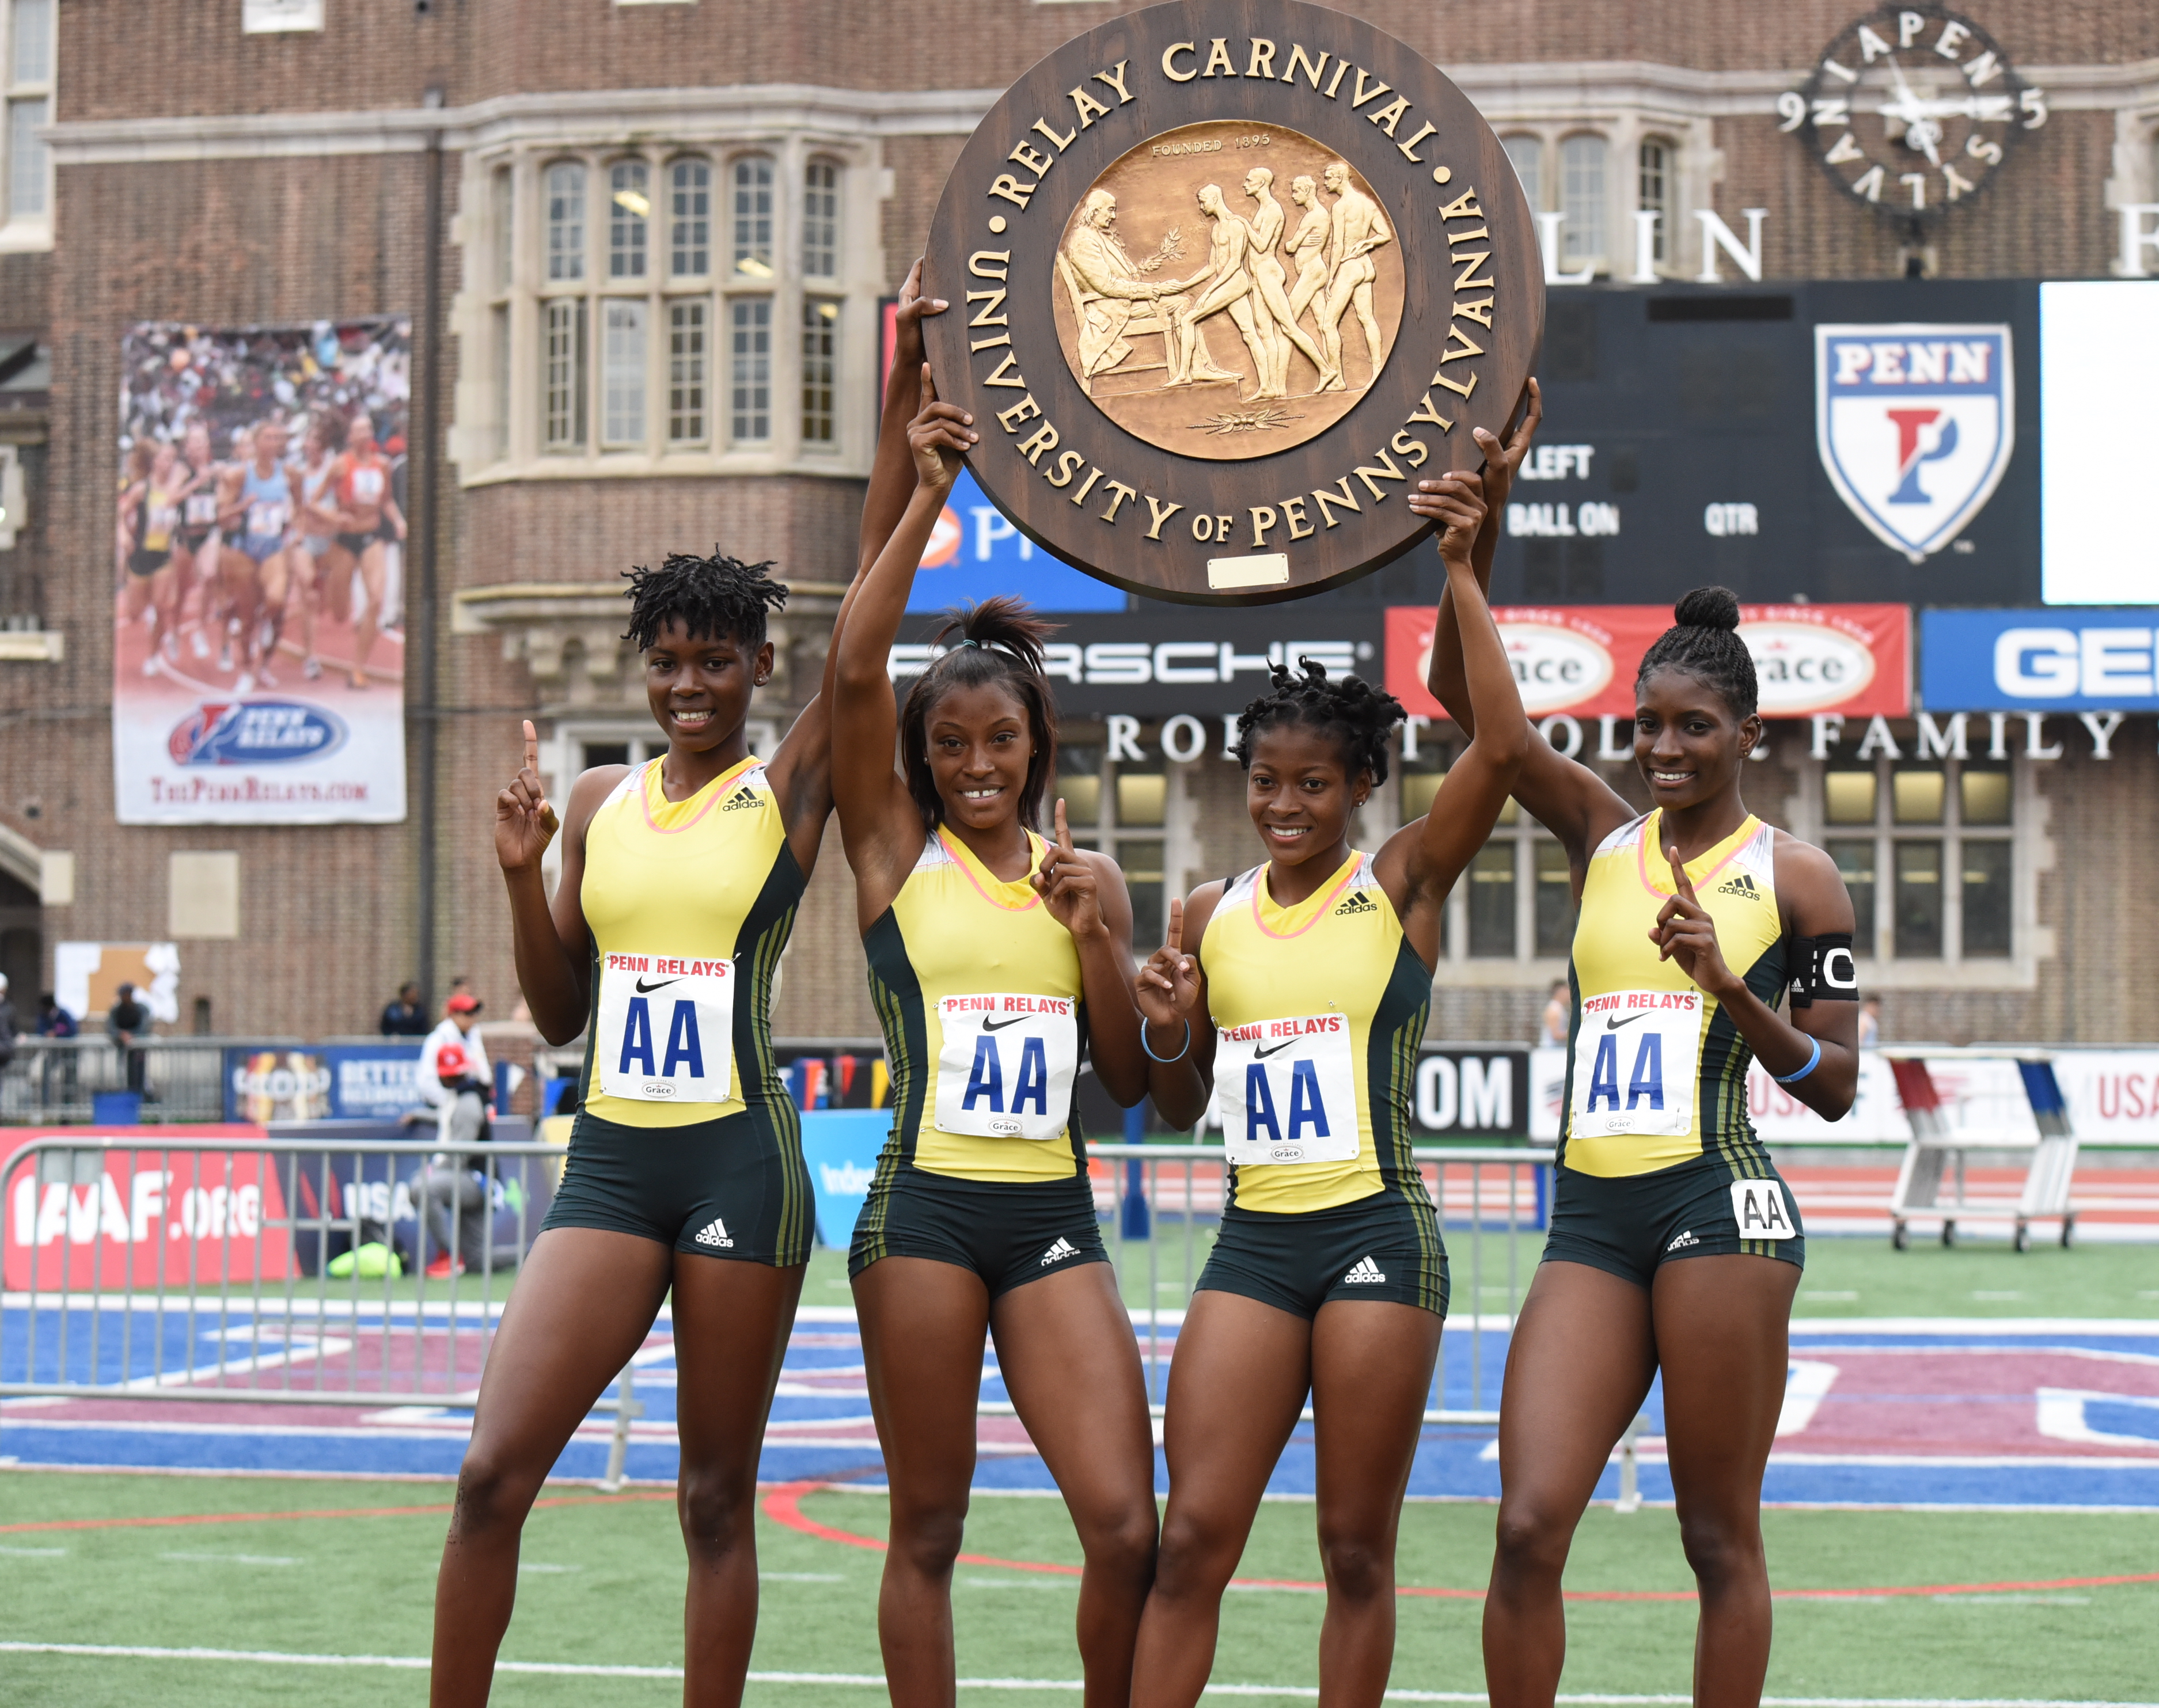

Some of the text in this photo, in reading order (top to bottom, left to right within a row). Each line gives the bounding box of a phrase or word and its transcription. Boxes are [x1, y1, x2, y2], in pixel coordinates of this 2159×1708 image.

[988, 37, 1438, 210] RELAY CARNIVAL
[1152, 134, 1270, 157] FOUNDED 1895
[965, 184, 1496, 548] UNIVERSITY OF PENNSYLVANIA
[1834, 341, 1992, 385] PENN
[1519, 445, 1594, 480] LEFT
[1507, 503, 1620, 536] BALL ON
[1705, 503, 1758, 536] QTR
[1810, 712, 2125, 760] FAMILY
[723, 800, 765, 811] adidas
[1335, 904, 1377, 915] adidas
[1718, 886, 1760, 901] adidas
[610, 955, 726, 978] PENN RELAYS
[1823, 948, 1856, 989] C
[947, 997, 1067, 1015] PENN RELAYS
[1586, 994, 1694, 1014] PENN RELAYS
[619, 997, 704, 1078] AA
[1223, 1017, 1340, 1042] PENN RELAYS
[961, 1035, 1047, 1115] AA
[1587, 1033, 1664, 1113] AA
[646, 1086, 671, 1094] Grace
[1246, 1060, 1330, 1141] AA
[1416, 1056, 1513, 1130] OM
[993, 1123, 1018, 1131] Grace
[1744, 1189, 1788, 1230] AA
[696, 1233, 734, 1247] adidas
[1345, 1271, 1386, 1284] adidas
